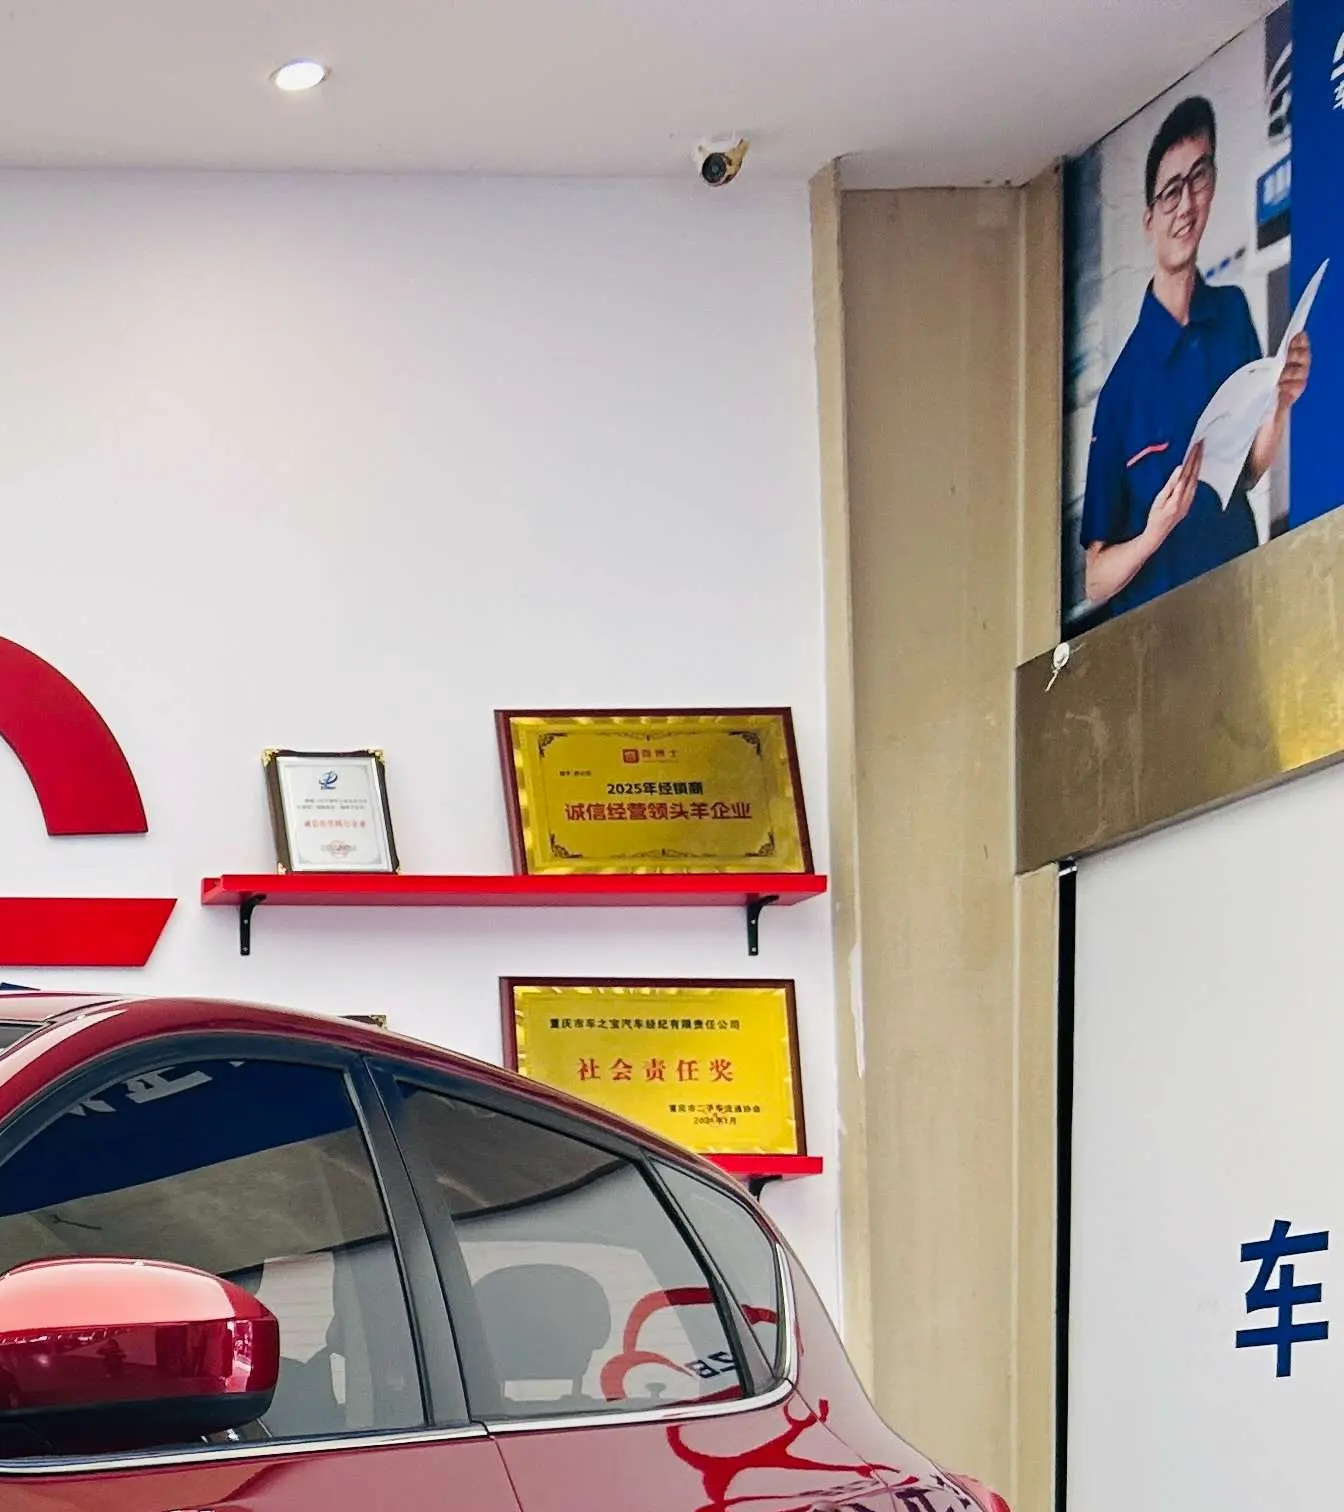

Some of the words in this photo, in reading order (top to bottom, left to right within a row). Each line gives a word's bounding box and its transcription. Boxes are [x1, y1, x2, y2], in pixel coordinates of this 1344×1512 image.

[607, 781, 704, 796] 2025年经销商
[565, 802, 753, 821] 诚信经营领头羊企业
[549, 1018, 741, 1030] 重庆市车之宝汽车经纪有限责任公司
[577, 1057, 734, 1082] 社会责任奖
